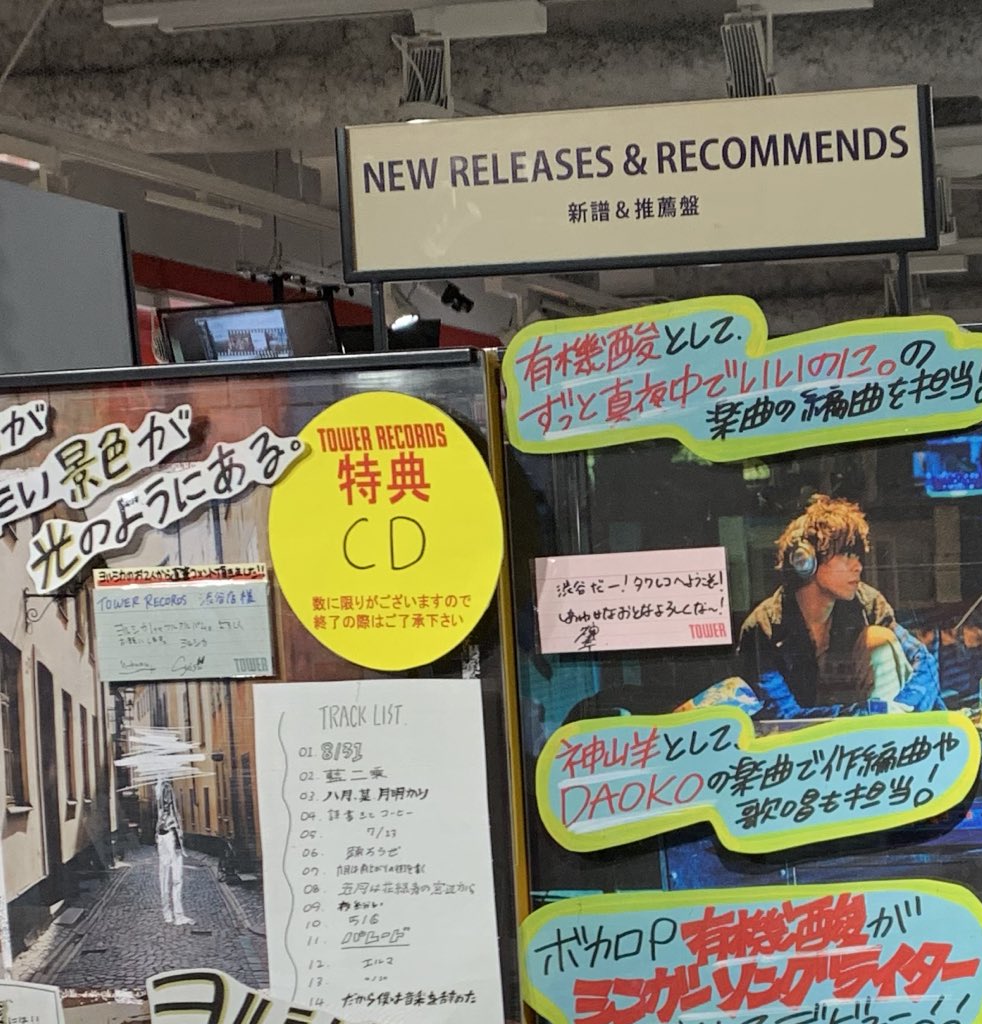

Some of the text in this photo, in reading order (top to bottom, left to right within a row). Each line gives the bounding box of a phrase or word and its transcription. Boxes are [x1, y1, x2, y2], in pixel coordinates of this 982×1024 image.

[362, 124, 909, 194] NEW RELEASES & RECOMMENDS
[567, 195, 700, 224] 新譜&推薦盤
[317, 423, 448, 452] TOWER RECORDS
[338, 451, 430, 505] 特典
[343, 516, 425, 570] CD
[97, 595, 141, 611] TOWER
[144, 594, 188, 608] RECORDS
[312, 594, 472, 611] 数に限りがございますので
[313, 614, 464, 630] 終了の際はご了承下さい
[689, 623, 727, 639] TOWER
[234, 657, 268, 672] TOWER
[318, 704, 366, 730] TRACK
